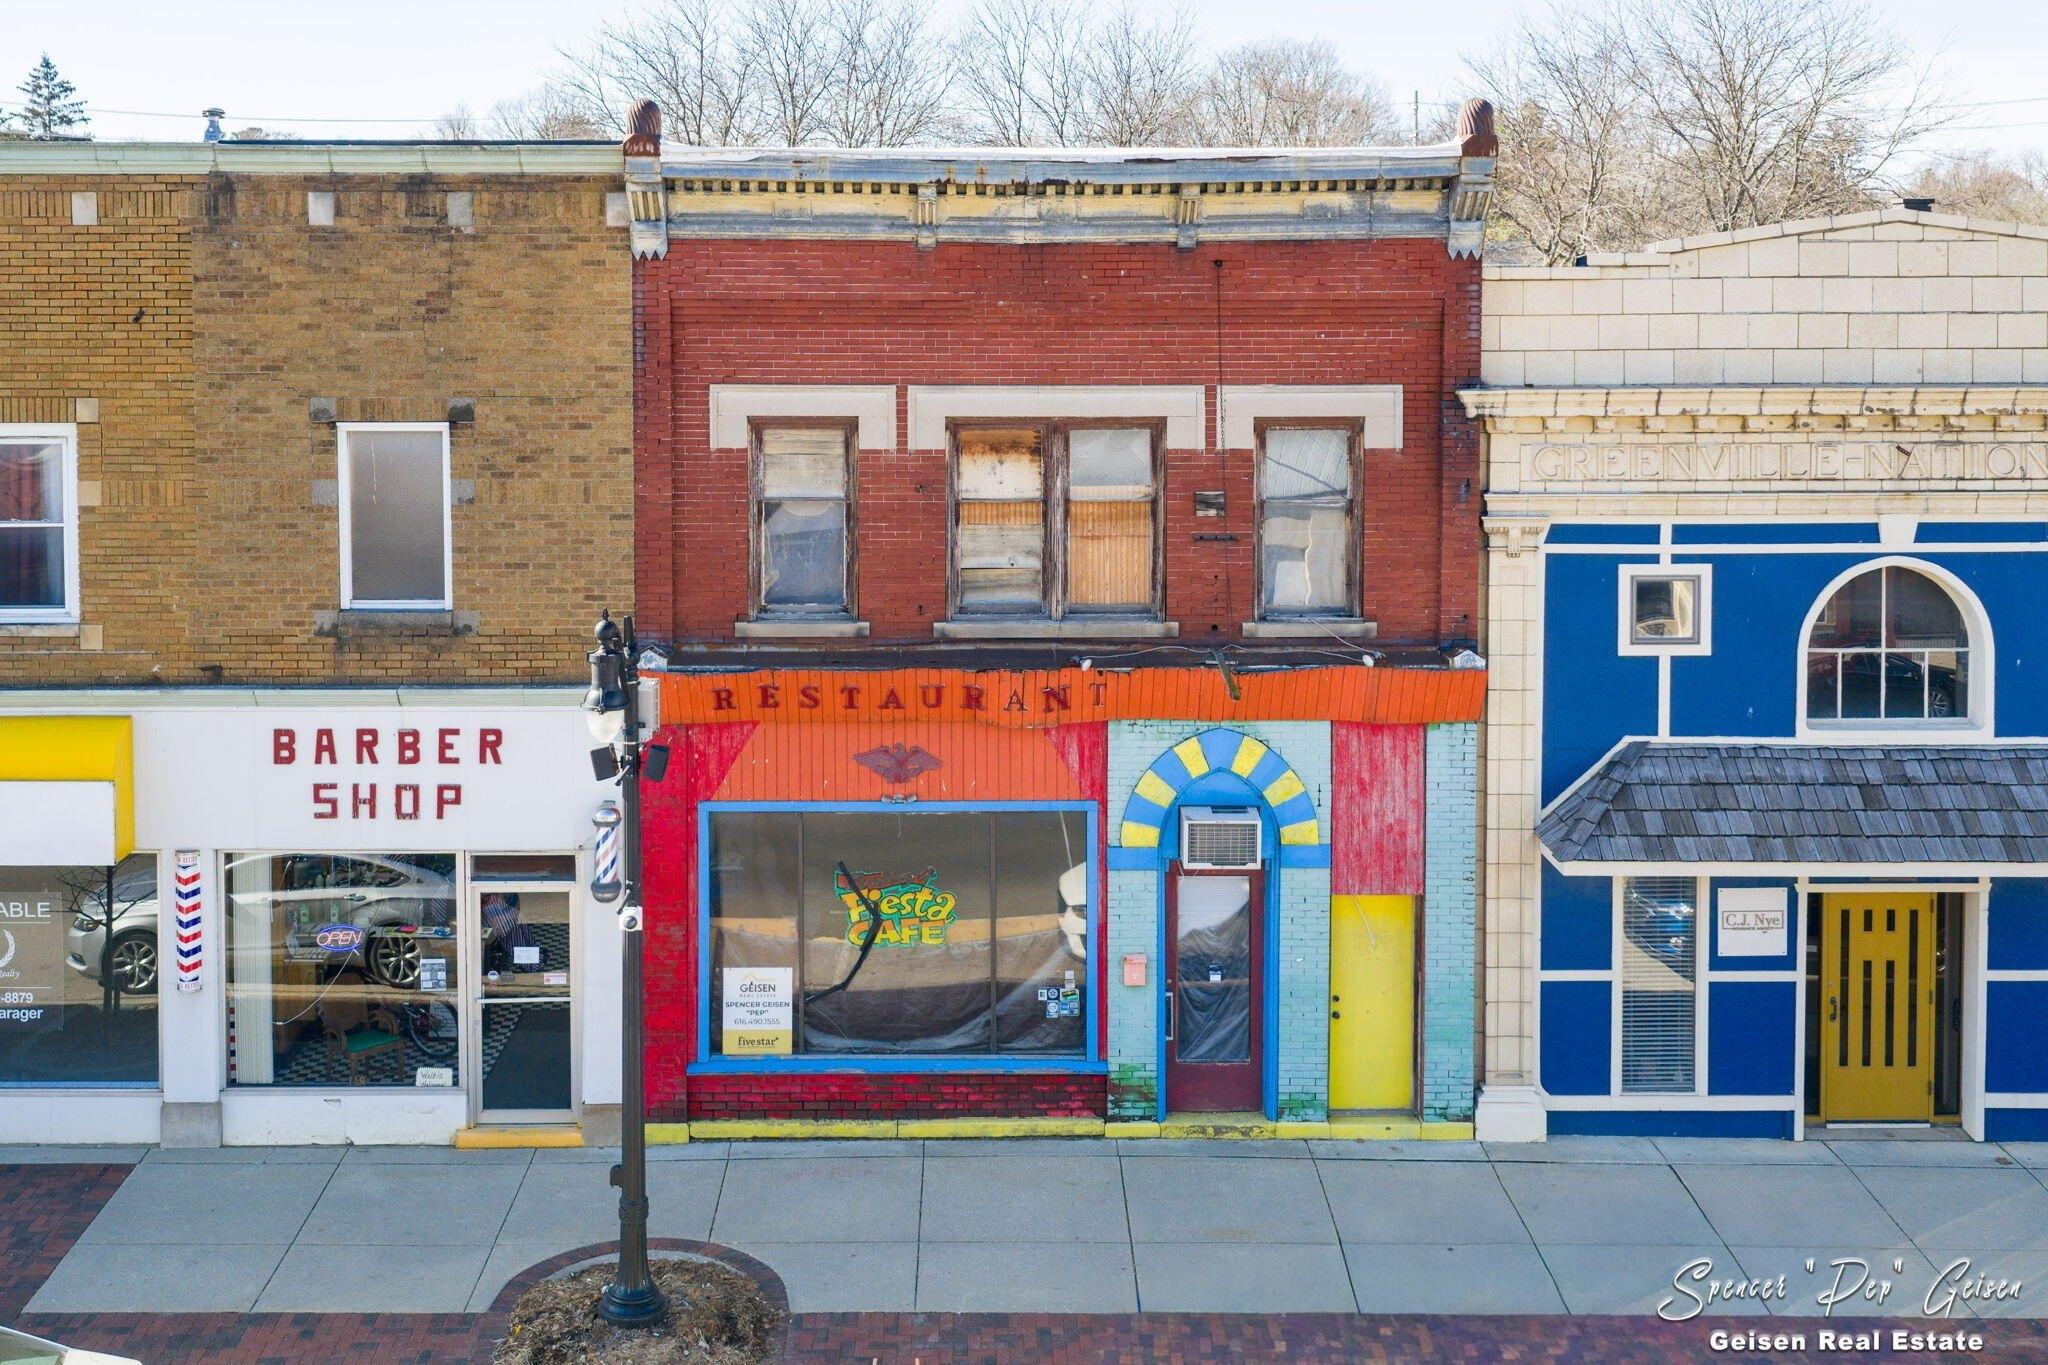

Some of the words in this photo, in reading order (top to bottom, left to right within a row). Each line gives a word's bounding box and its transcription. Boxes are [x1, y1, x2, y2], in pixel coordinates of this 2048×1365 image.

[712, 683, 1108, 713] RESTAURANT
[273, 728, 502, 765] BARBER
[313, 783, 462, 820] SHOP
[840, 886, 957, 923] Fiesta
[848, 918, 946, 946] CAFE
[1726, 913, 1750, 927] C.J.
[1754, 913, 1780, 929] Nye
[317, 931, 362, 946] OPEN
[740, 983, 776, 993] GEISEN
